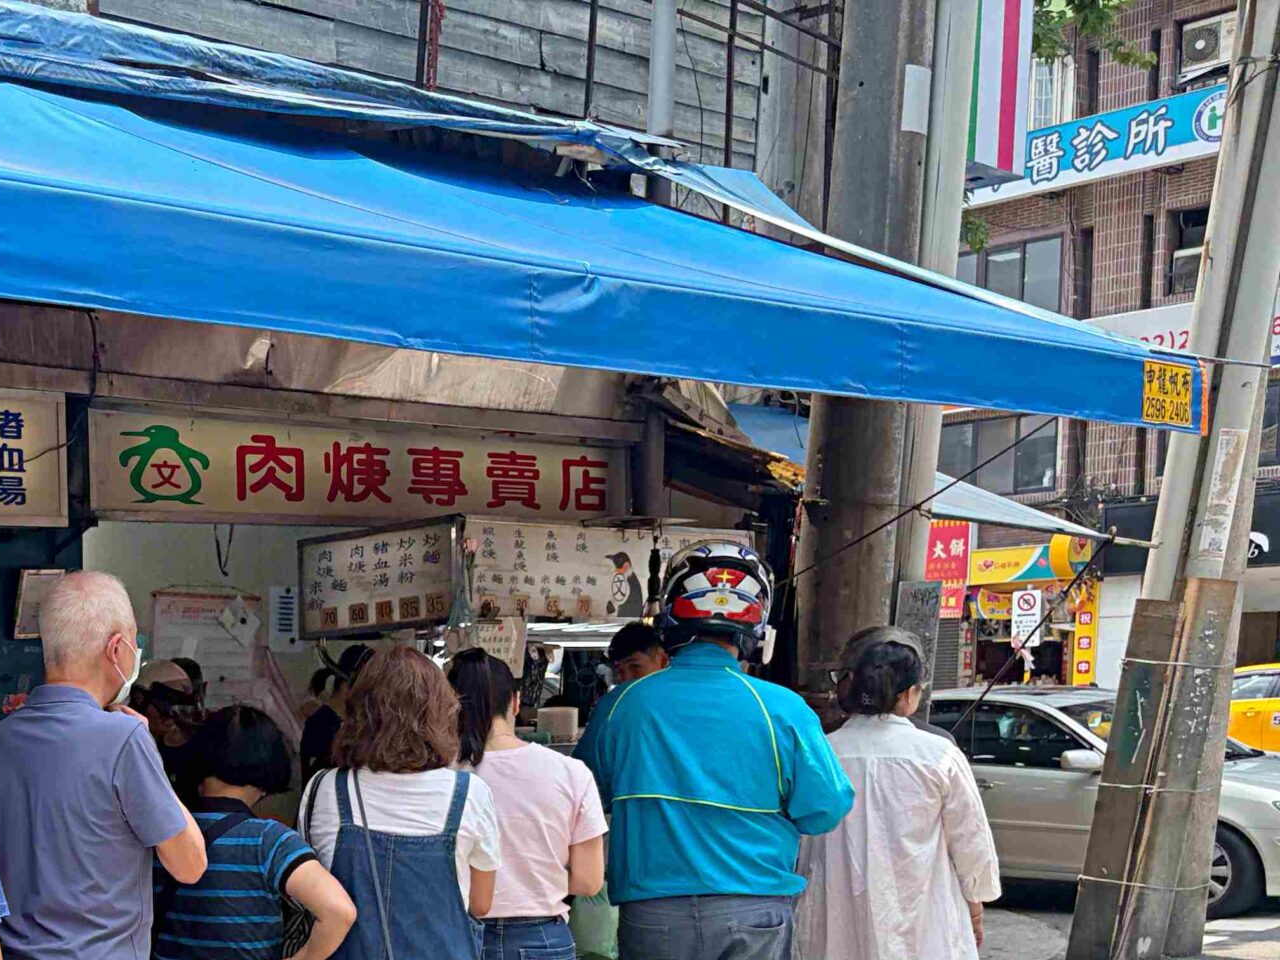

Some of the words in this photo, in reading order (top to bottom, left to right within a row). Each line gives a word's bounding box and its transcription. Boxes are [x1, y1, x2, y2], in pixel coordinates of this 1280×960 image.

[1026, 104, 1174, 185] 醫診所
[1145, 365, 1192, 398] 申龍帆布
[1145, 397, 1189, 423] 2596-2406
[150, 460, 183, 490] 文
[236, 434, 610, 512] 肉焿專賣店
[397, 536, 417, 585] 炒米粉
[932, 538, 965, 560] 大餅
[324, 612, 336, 626] 70
[402, 602, 419, 619] 35
[427, 596, 444, 614] 35
